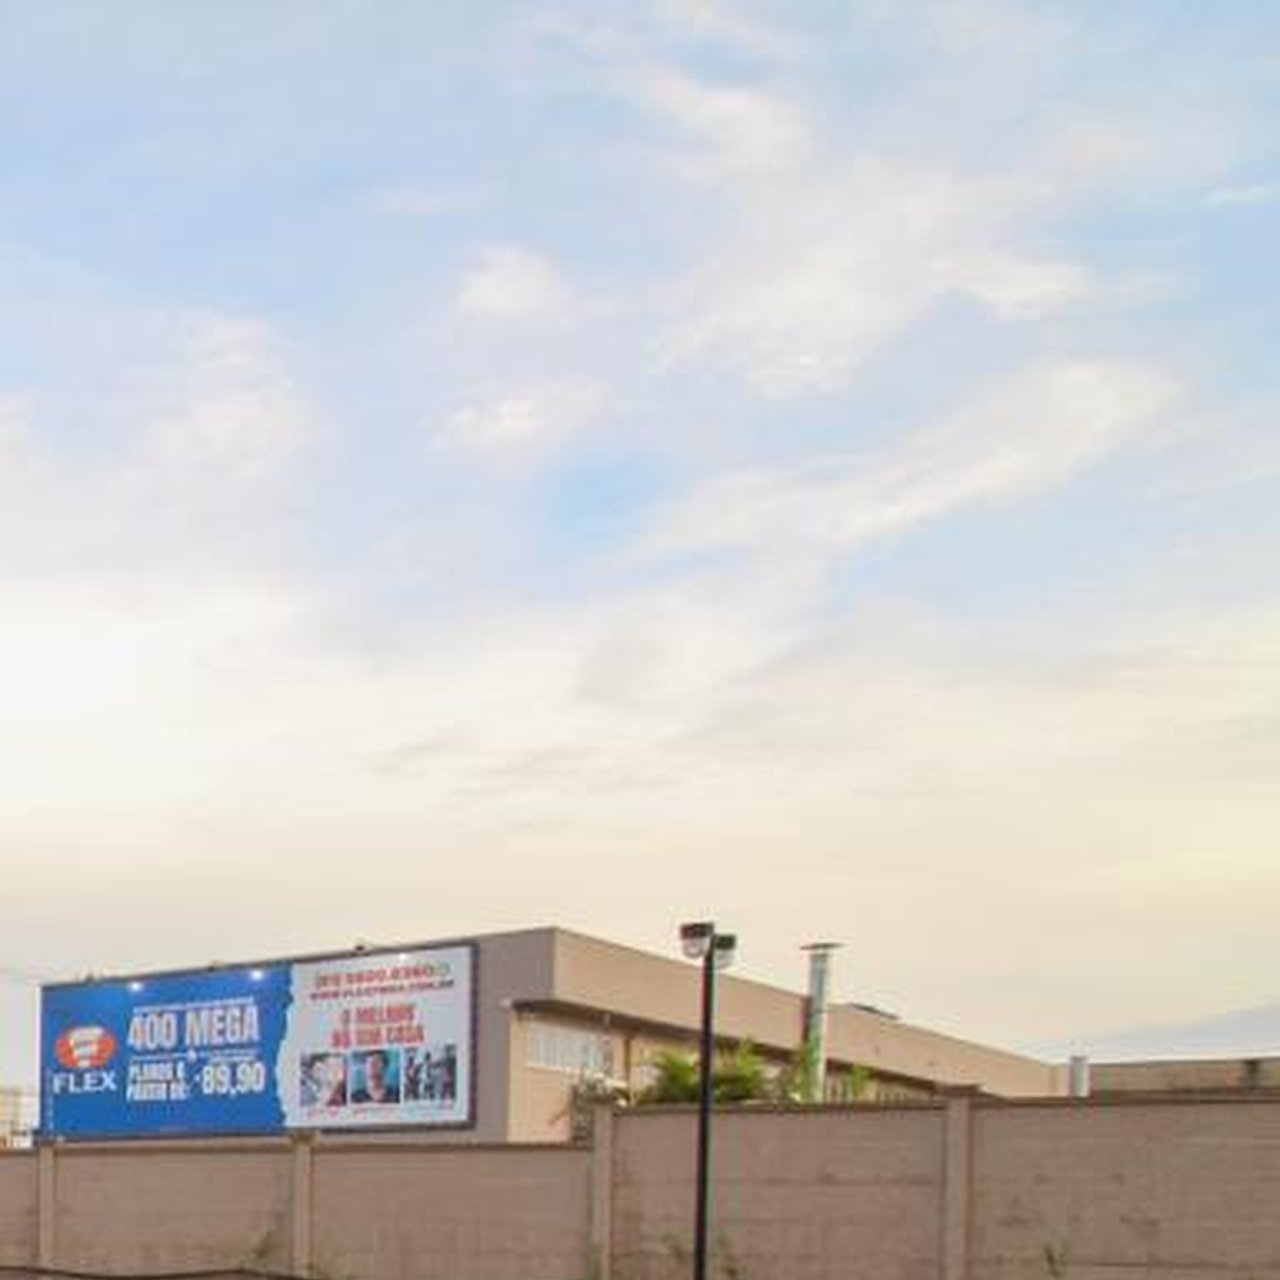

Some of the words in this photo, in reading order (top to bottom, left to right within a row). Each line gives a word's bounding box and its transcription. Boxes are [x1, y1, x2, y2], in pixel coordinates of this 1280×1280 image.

[127, 1013, 177, 1050] 400
[185, 1006, 260, 1047] MEGA
[52, 1071, 118, 1094] FLEX
[201, 1062, 266, 1096] 89,90
